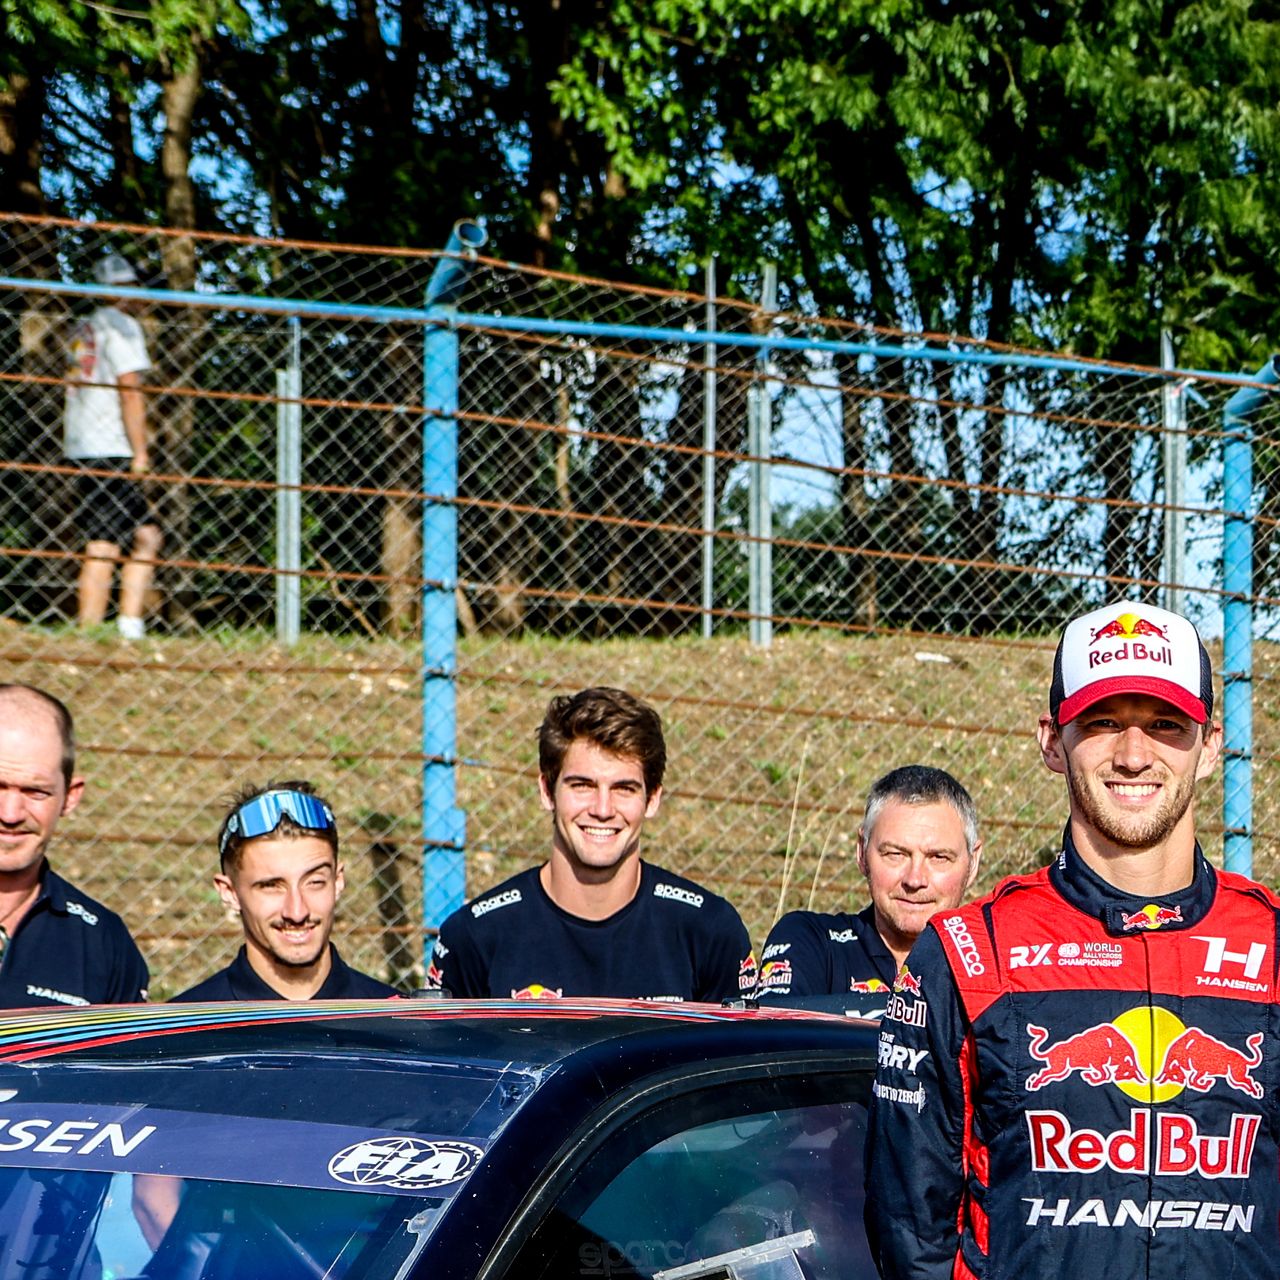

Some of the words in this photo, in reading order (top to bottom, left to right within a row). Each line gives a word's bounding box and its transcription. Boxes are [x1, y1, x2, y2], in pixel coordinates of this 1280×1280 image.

[1089, 643, 1129, 668] Red
[1133, 643, 1172, 666] Bull
[471, 888, 522, 918] sparco
[653, 882, 704, 909] sparco
[943, 916, 985, 978] sparco
[1010, 943, 1053, 969] RX
[1084, 942, 1122, 953] WORLD
[1058, 958, 1122, 967] CHAMPIONSHIP
[1195, 975, 1268, 992] HANSEN
[893, 997, 928, 1028] Bull
[1025, 1109, 1152, 1176] Red
[1155, 1113, 1262, 1179] Bull
[1020, 1198, 1257, 1234] HANSEN
